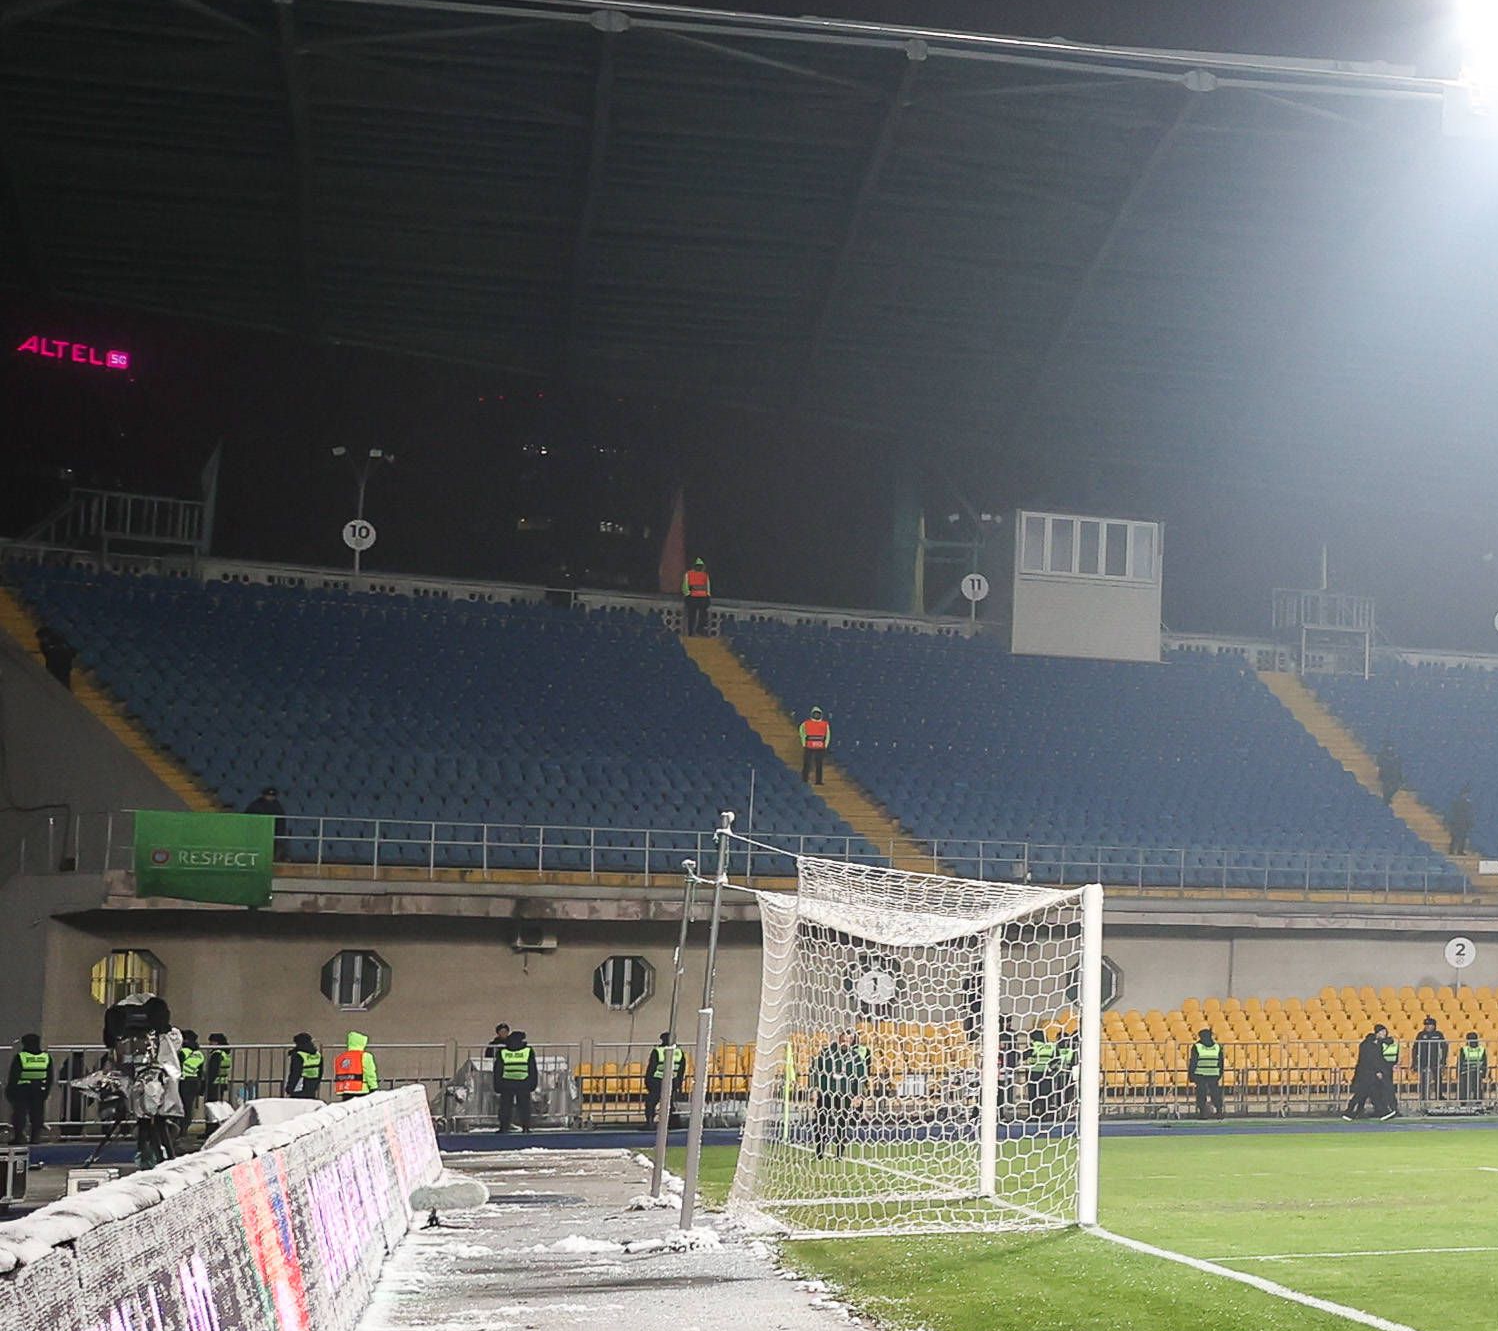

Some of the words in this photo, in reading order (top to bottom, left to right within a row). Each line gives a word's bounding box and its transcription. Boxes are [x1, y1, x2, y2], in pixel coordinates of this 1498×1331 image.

[17, 335, 104, 366] ALTEL
[350, 525, 370, 539] 10
[969, 578, 982, 591] 11
[178, 850, 260, 867] RESPECT
[1454, 943, 1466, 956] 2
